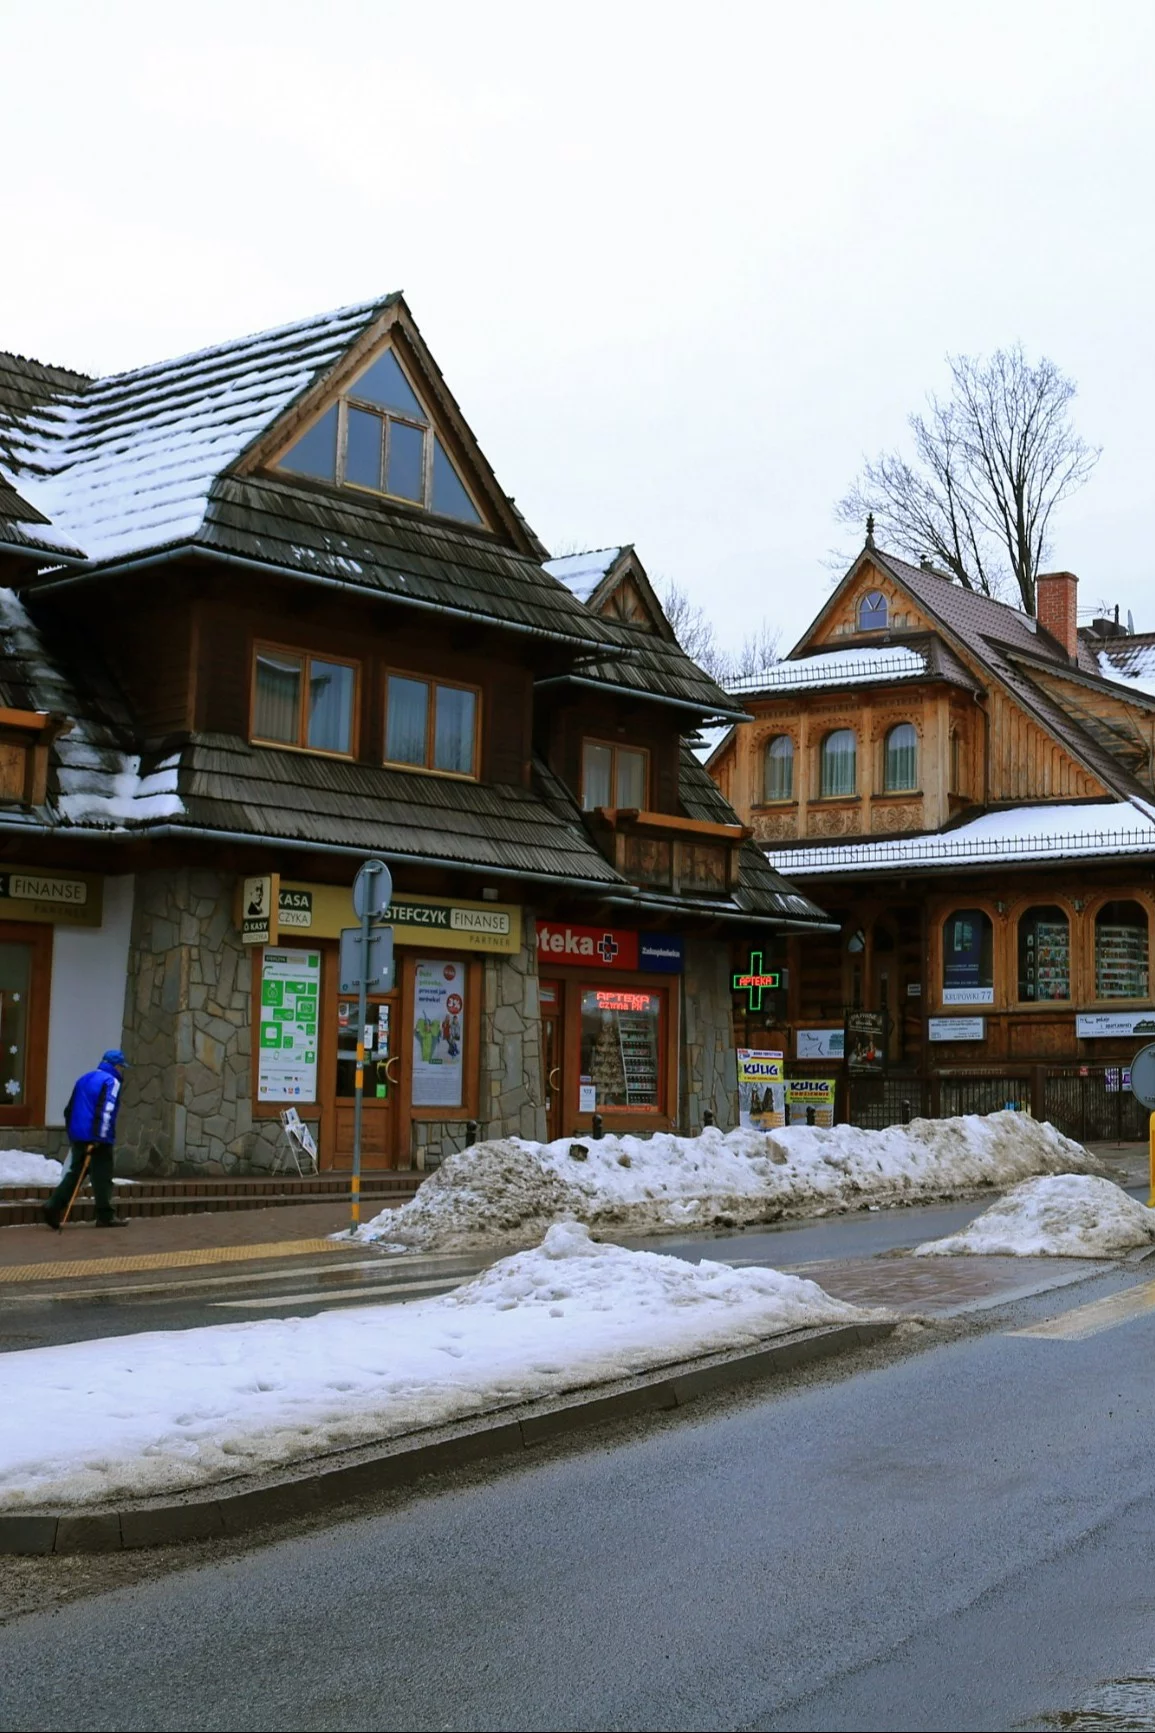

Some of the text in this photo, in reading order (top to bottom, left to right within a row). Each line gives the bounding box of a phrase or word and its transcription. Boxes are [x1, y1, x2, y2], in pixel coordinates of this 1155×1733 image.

[15, 880, 81, 900] FINANSE
[278, 893, 309, 908] KASA
[384, 906, 505, 930] STEFCZYK FINANSE
[470, 935, 510, 947] PARTNER
[536, 927, 594, 955] teka
[739, 975, 773, 986] APTEKA
[596, 992, 650, 1004] APTEKA
[981, 991, 992, 1001] 77
[599, 1001, 629, 1010] czynna
[743, 1063, 778, 1075] KULIG
[790, 1081, 829, 1091] KULIG
